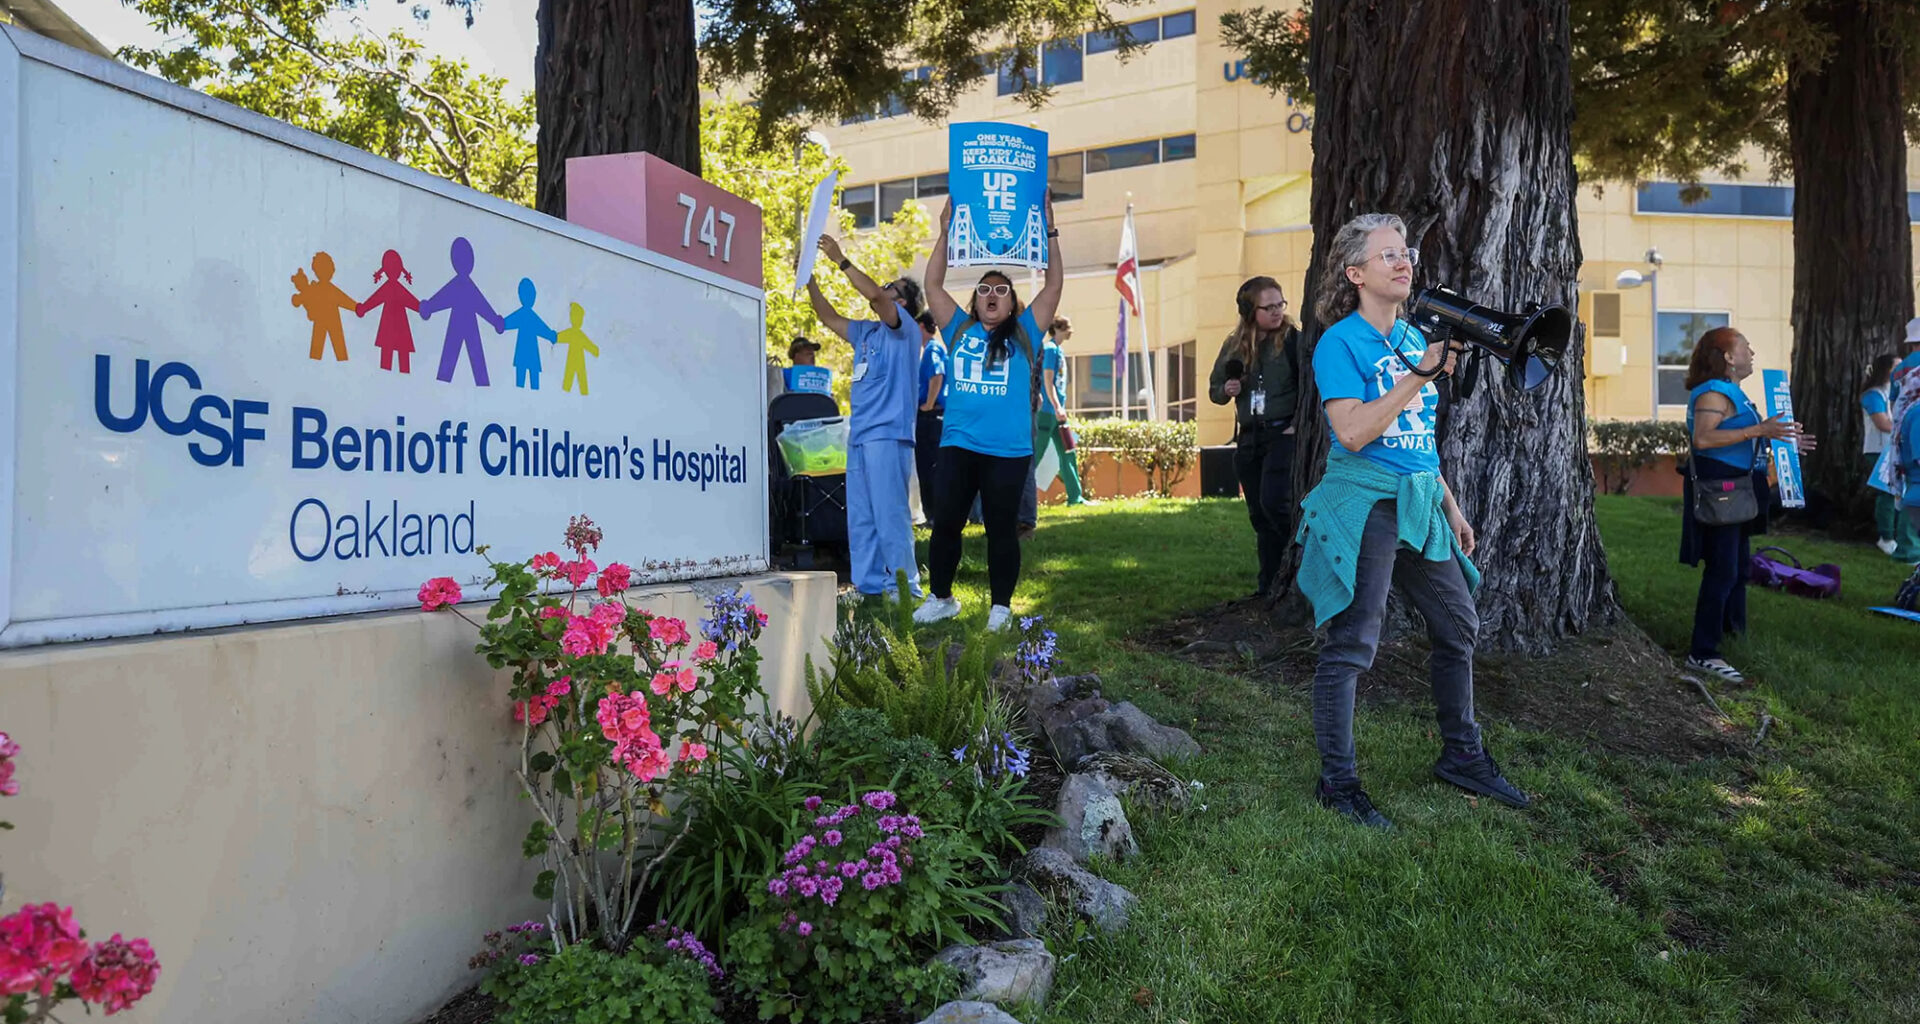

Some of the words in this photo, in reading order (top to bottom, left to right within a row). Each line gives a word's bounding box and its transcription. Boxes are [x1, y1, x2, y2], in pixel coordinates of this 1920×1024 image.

[1007, 141, 1021, 149] TOO
[963, 155, 975, 165] IN
[978, 154, 1036, 169] OAKLAND
[1015, 151, 1036, 161] CARE
[983, 172, 1017, 191] UP
[983, 190, 1016, 210] TE
[677, 192, 736, 263] 747
[955, 382, 978, 394] CWA
[981, 384, 1007, 396] 9119
[95, 354, 269, 467] UCSF
[292, 406, 468, 474] Benioff
[479, 423, 645, 480] Children’s
[653, 438, 747, 491] Hospital
[1383, 436, 1425, 450] CWA
[289, 498, 474, 562] Oakland
